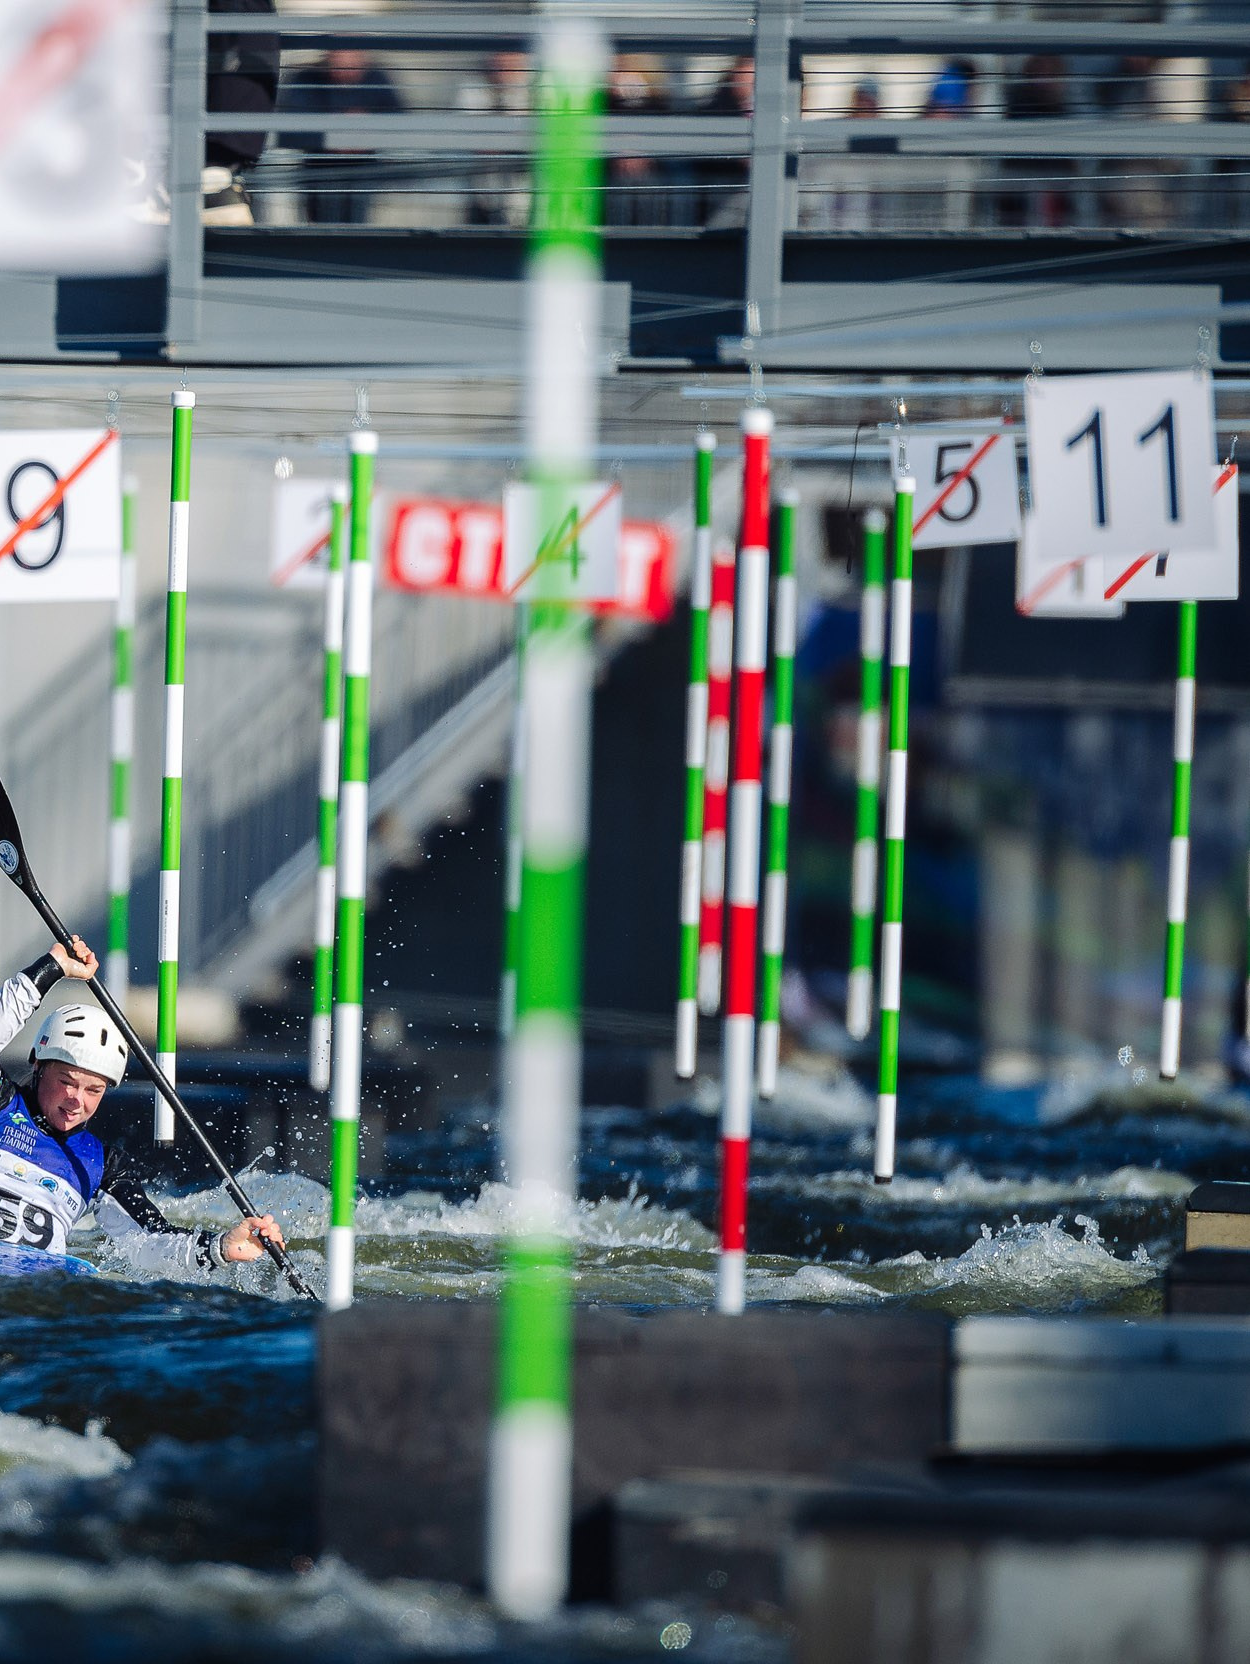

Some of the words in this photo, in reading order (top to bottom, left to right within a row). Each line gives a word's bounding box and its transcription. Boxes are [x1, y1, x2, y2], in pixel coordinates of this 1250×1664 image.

[934, 442, 981, 522] 5
[1065, 403, 1180, 527] 11
[7, 460, 66, 571] 9
[535, 505, 585, 582] 4
[66, 1197, 79, 1211] ВТБ
